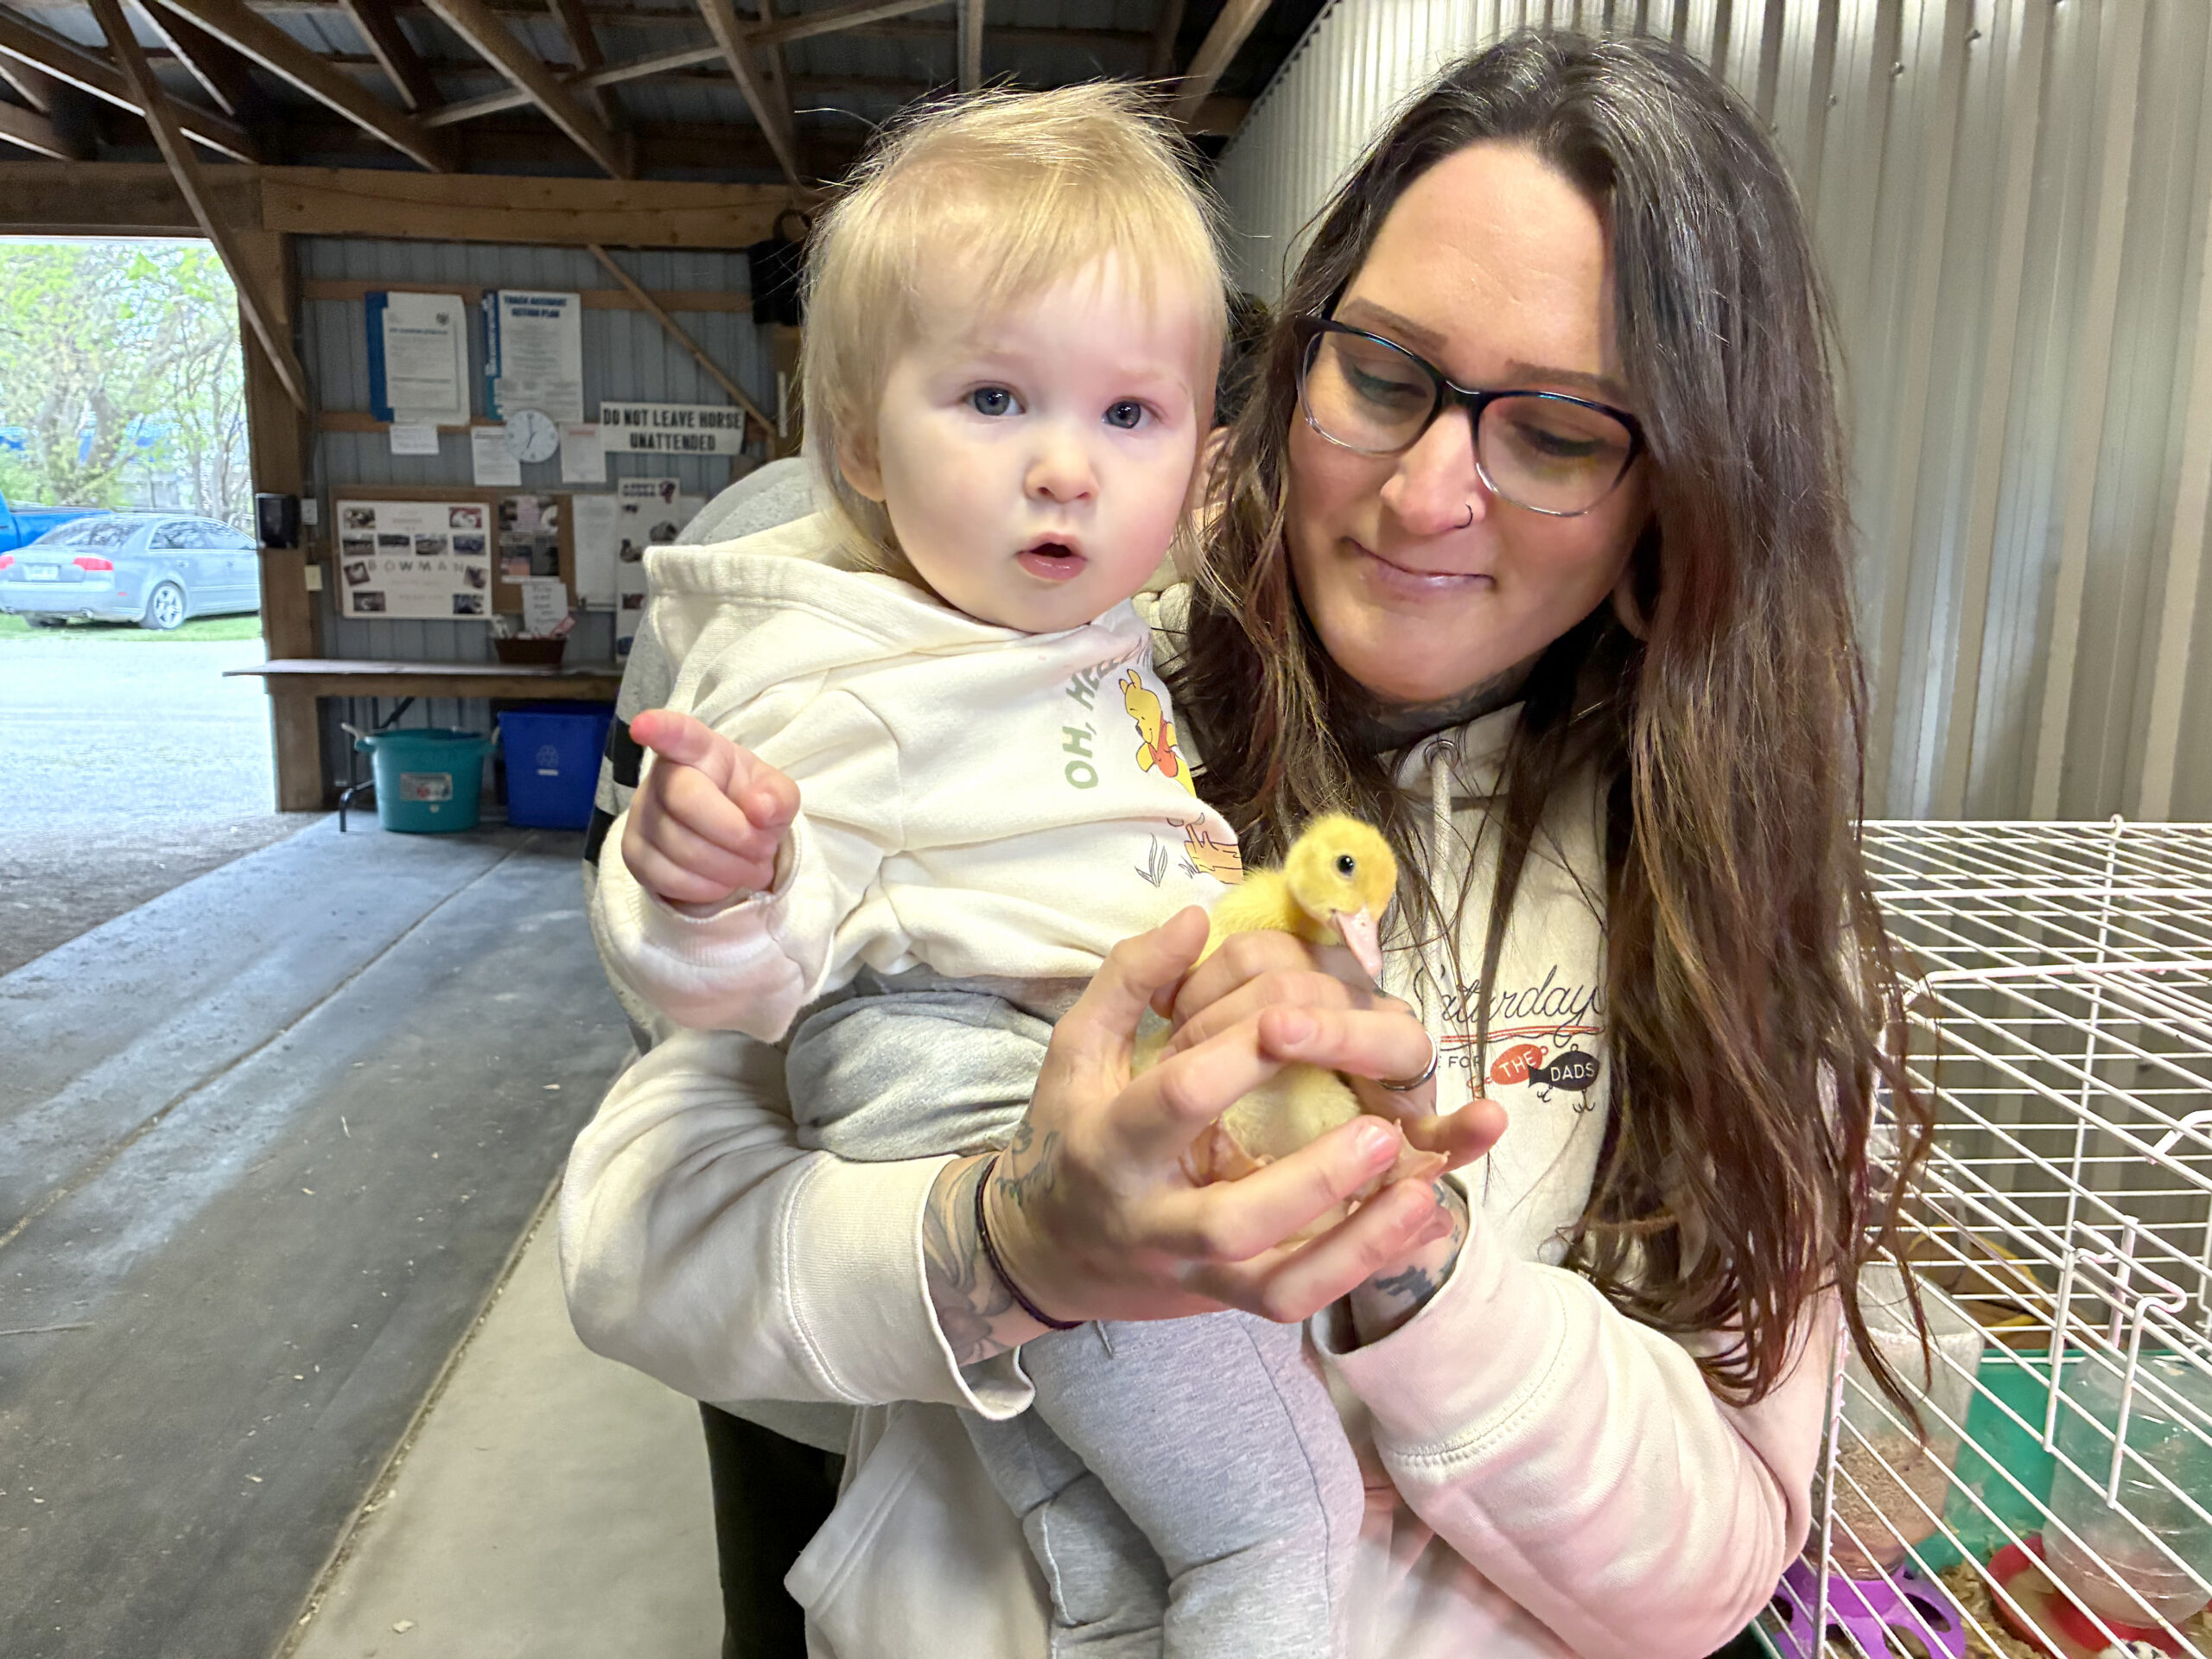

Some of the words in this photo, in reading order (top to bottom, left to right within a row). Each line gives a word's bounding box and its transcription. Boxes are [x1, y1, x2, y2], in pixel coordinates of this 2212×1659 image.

[603, 408, 620, 426] DO
[624, 409, 649, 427] NOT
[652, 410, 695, 428] LEAVE
[699, 411, 742, 429] HORSE
[630, 433, 716, 451] UNATTENDED
[1062, 722, 1098, 789] OH,
[1498, 1049, 1536, 1077] THE
[1550, 1063, 1595, 1081] DADS
